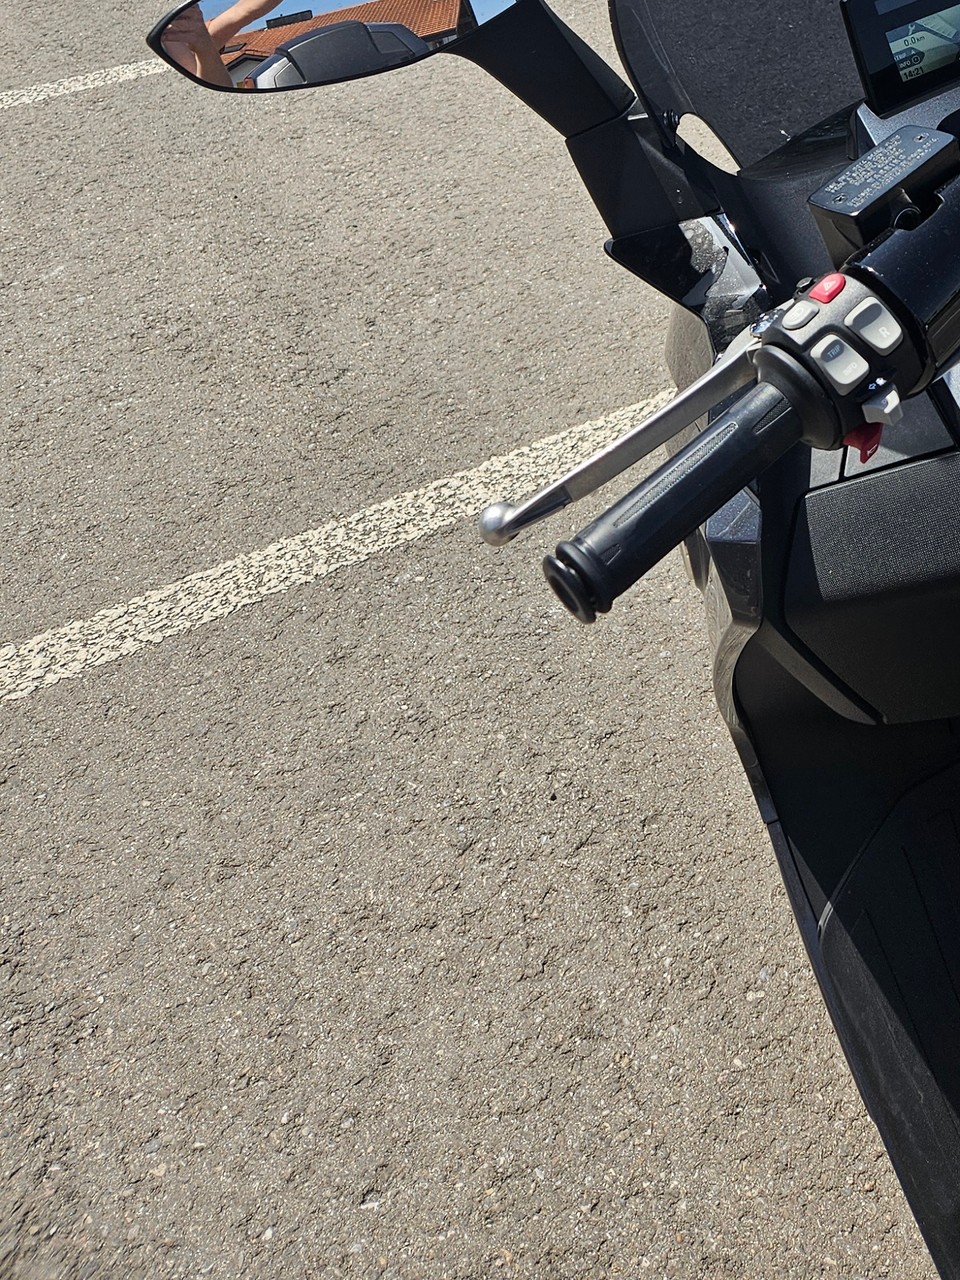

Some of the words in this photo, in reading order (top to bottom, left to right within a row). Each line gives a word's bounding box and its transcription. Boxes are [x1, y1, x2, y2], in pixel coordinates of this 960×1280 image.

[903, 66, 924, 80] 14:21
[878, 326, 890, 338] R
[827, 345, 841, 358] TRIP
